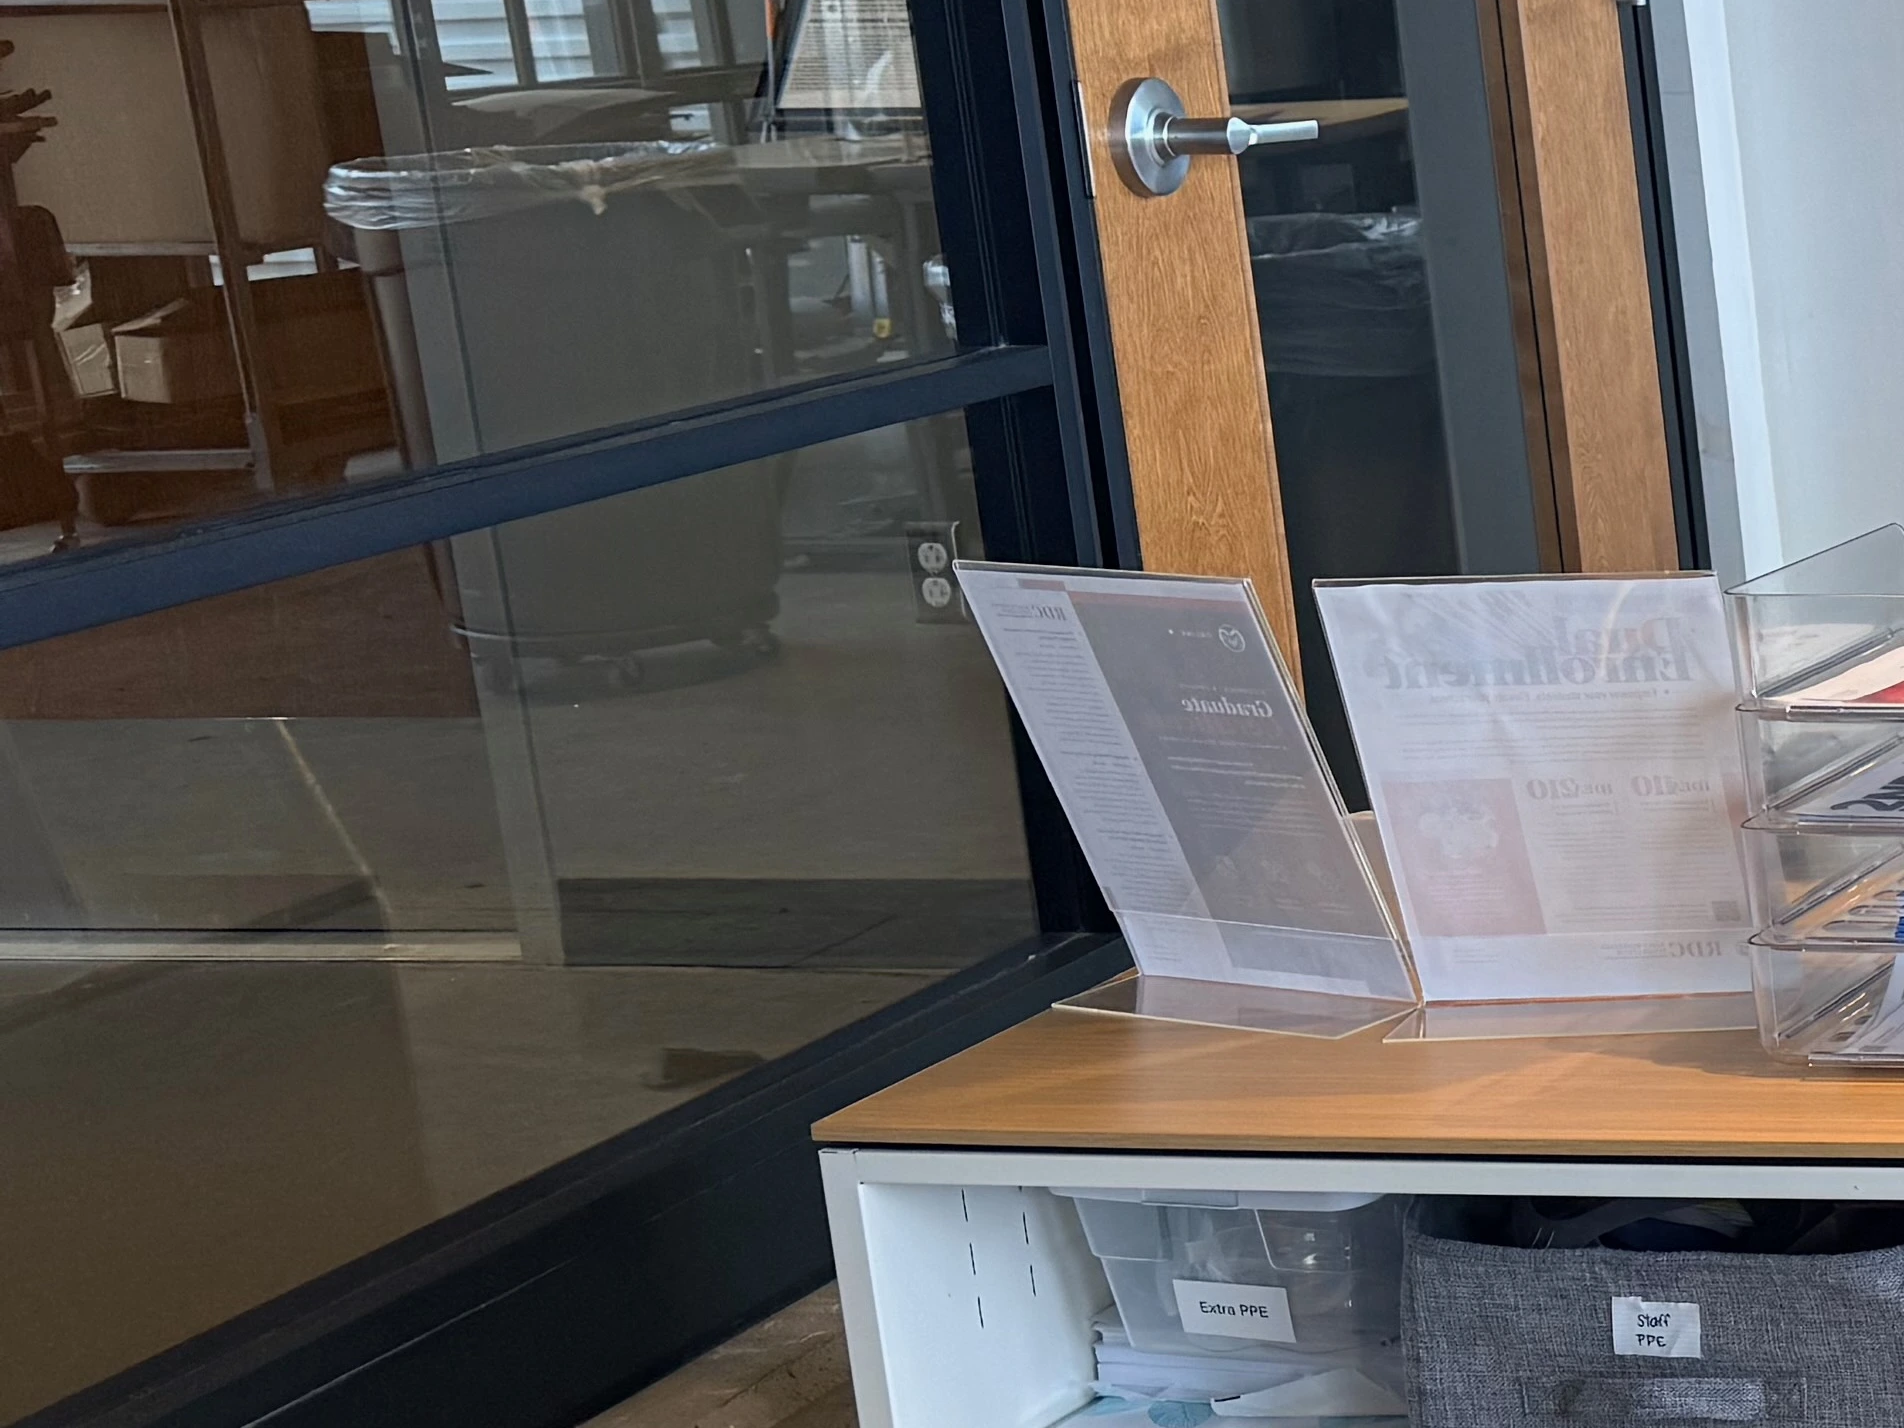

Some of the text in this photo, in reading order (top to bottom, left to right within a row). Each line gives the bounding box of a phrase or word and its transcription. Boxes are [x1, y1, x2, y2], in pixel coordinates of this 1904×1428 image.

[1199, 1301, 1269, 1318] Extra PPE
[1637, 1313, 1671, 1328] Staff
[1636, 1334, 1667, 1347] PPE
